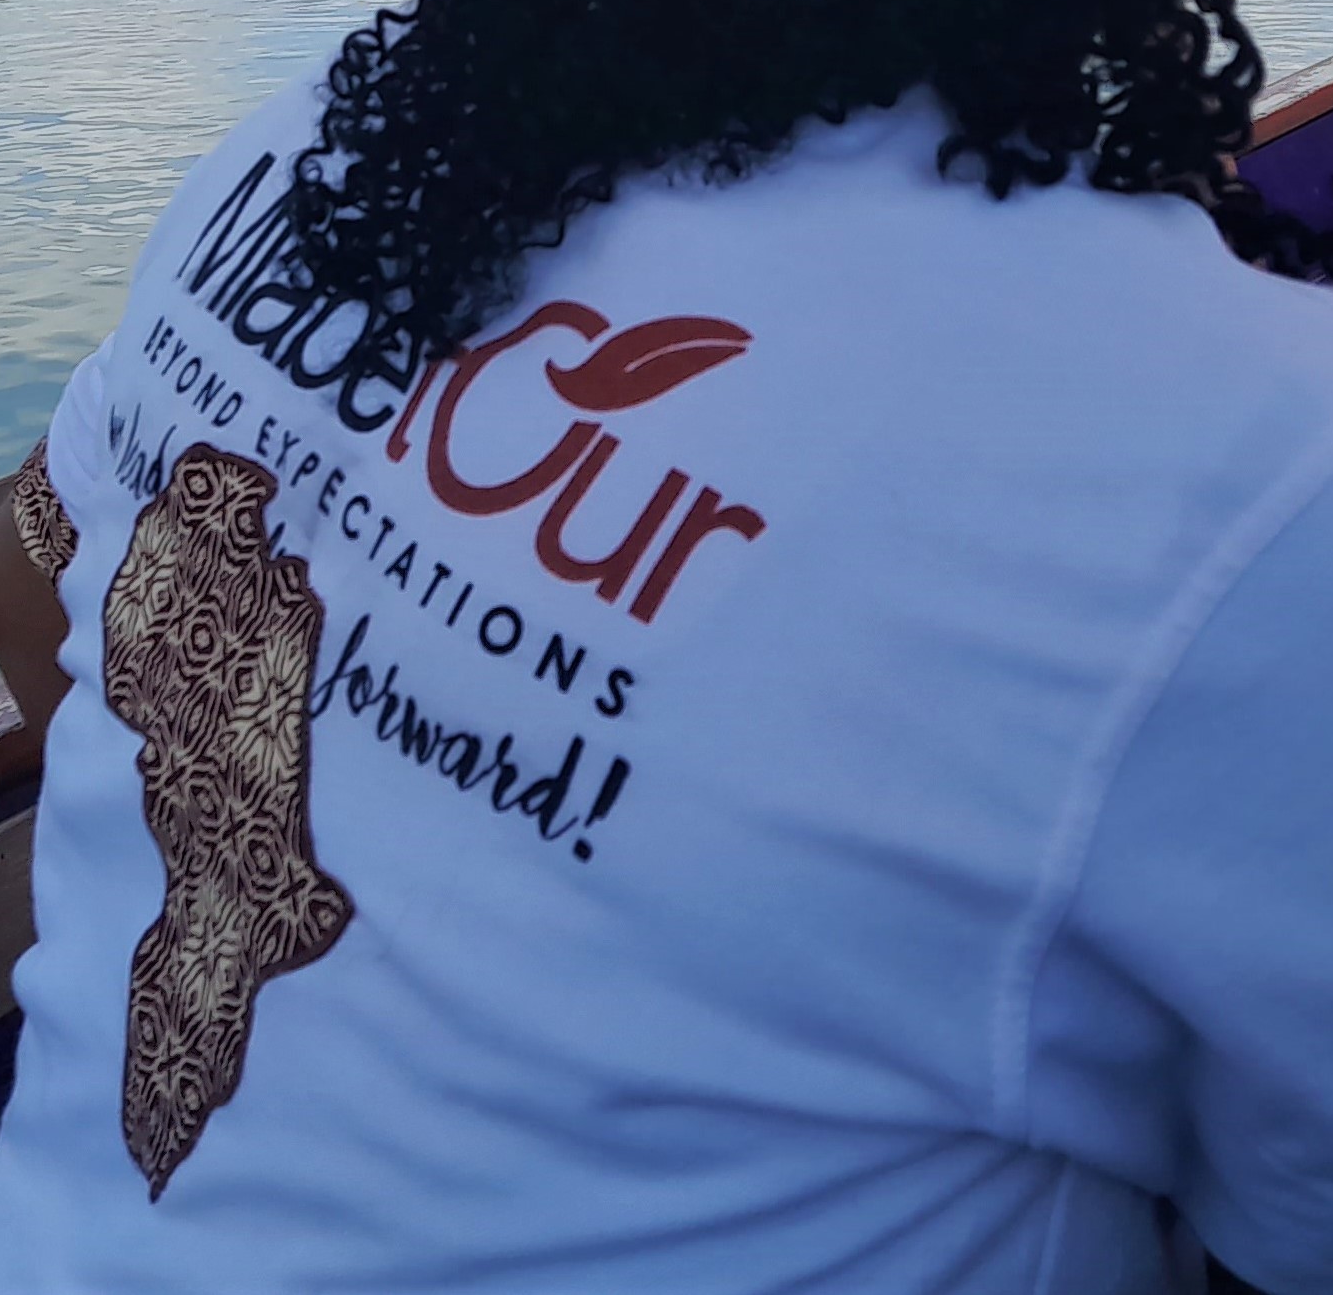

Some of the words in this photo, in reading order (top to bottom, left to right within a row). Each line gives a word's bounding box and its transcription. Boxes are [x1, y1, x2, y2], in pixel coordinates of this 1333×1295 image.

[142, 315, 245, 428] BEYOND
[255, 414, 636, 717] EXPECTATIONS
[310, 613, 631, 863] forward!
